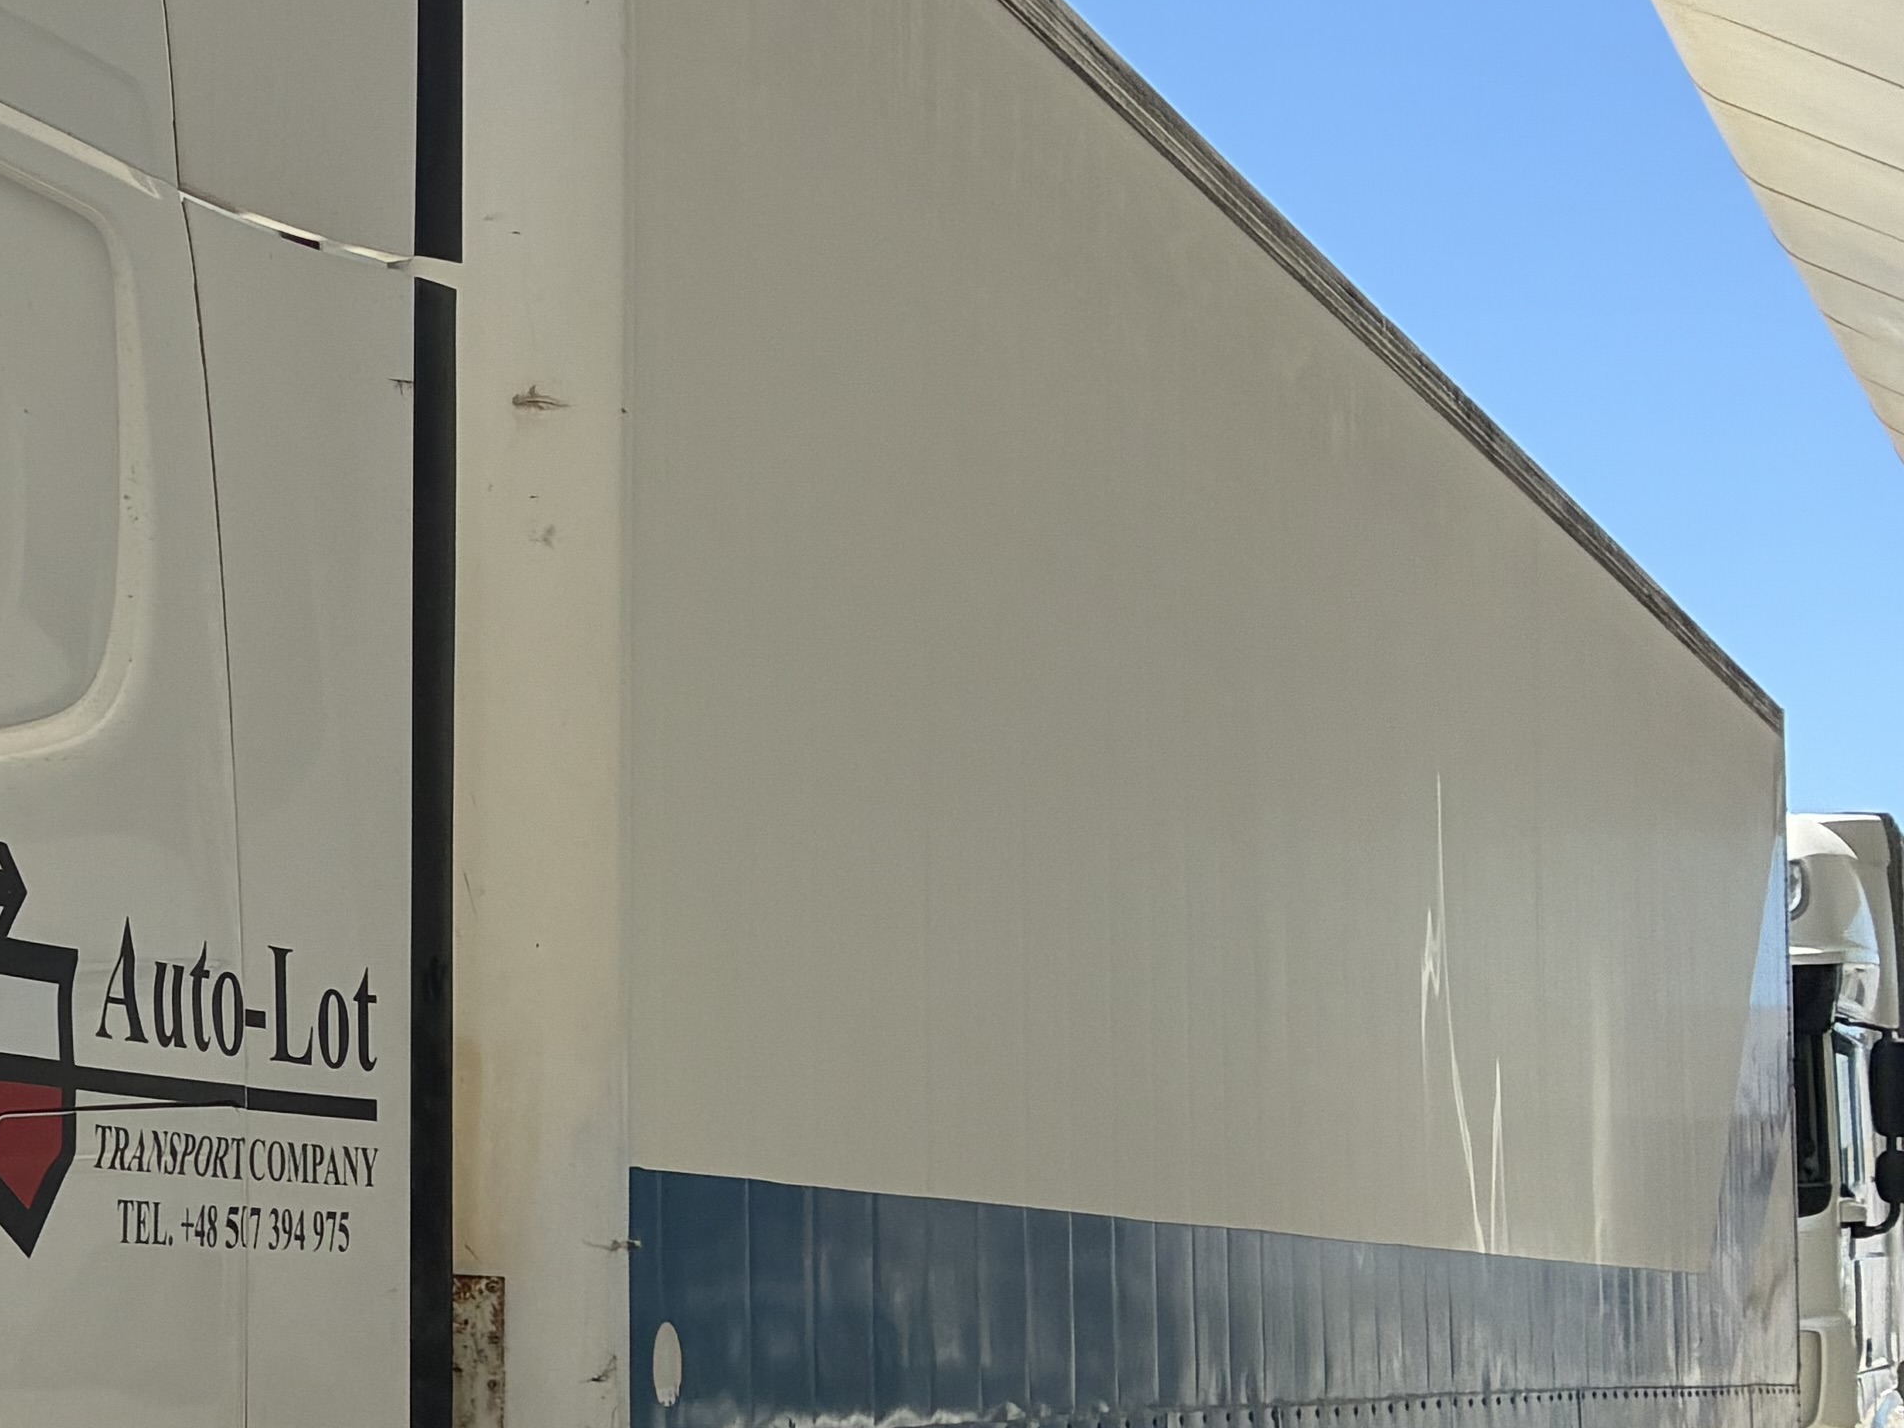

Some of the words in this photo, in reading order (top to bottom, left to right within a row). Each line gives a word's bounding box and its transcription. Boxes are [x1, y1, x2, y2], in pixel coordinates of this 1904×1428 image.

[95, 916, 378, 1072] Auto-Lot
[94, 1124, 247, 1181] TRANSPORT
[249, 1138, 379, 1188] COMPANY
[117, 1199, 172, 1246] TEL.
[181, 1205, 217, 1248] +48
[266, 1208, 306, 1251] 394
[312, 1211, 350, 1254] 975
